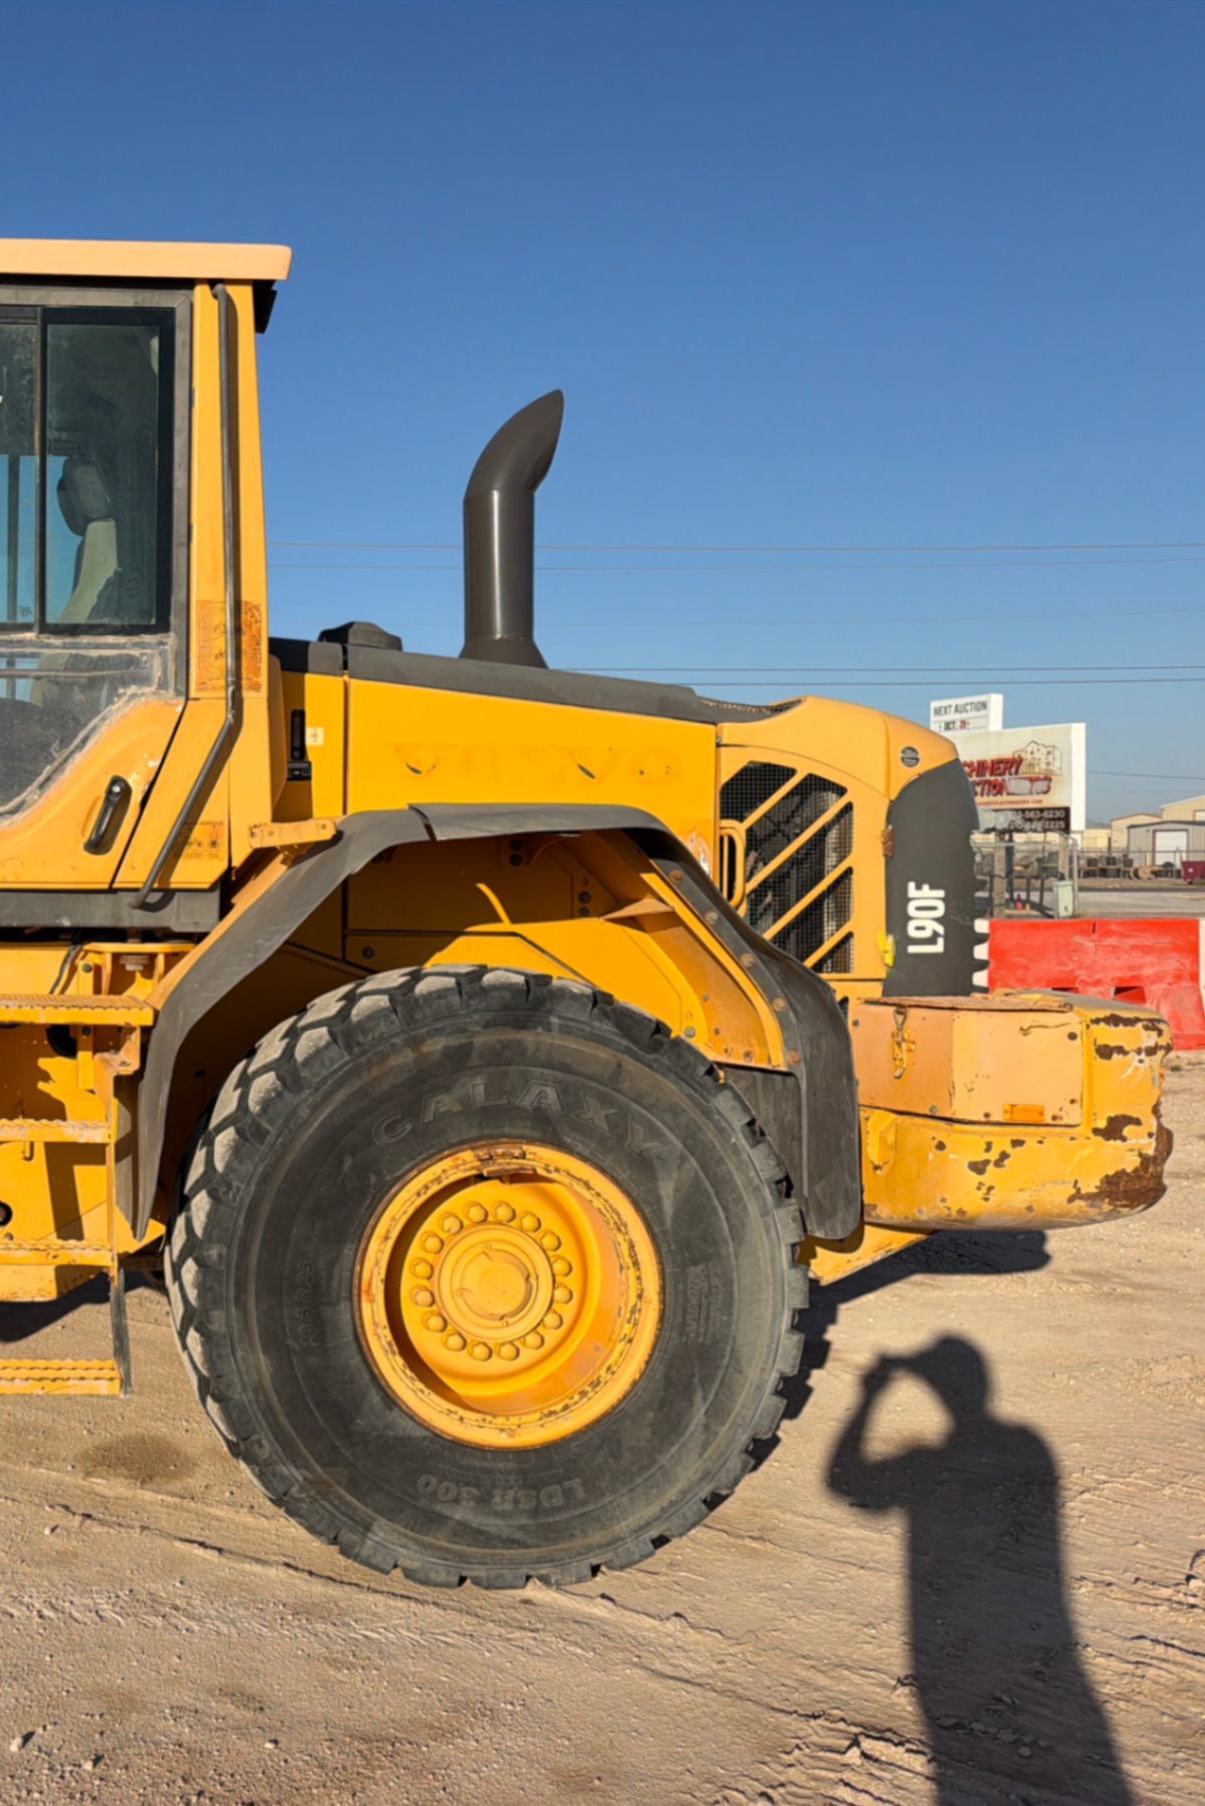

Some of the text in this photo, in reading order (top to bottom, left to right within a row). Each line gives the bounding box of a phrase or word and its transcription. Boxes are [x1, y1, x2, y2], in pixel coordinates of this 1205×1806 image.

[934, 701, 987, 717] NEXT AUCTION
[907, 881, 945, 954] L90F
[372, 1080, 660, 1156] GALAXY
